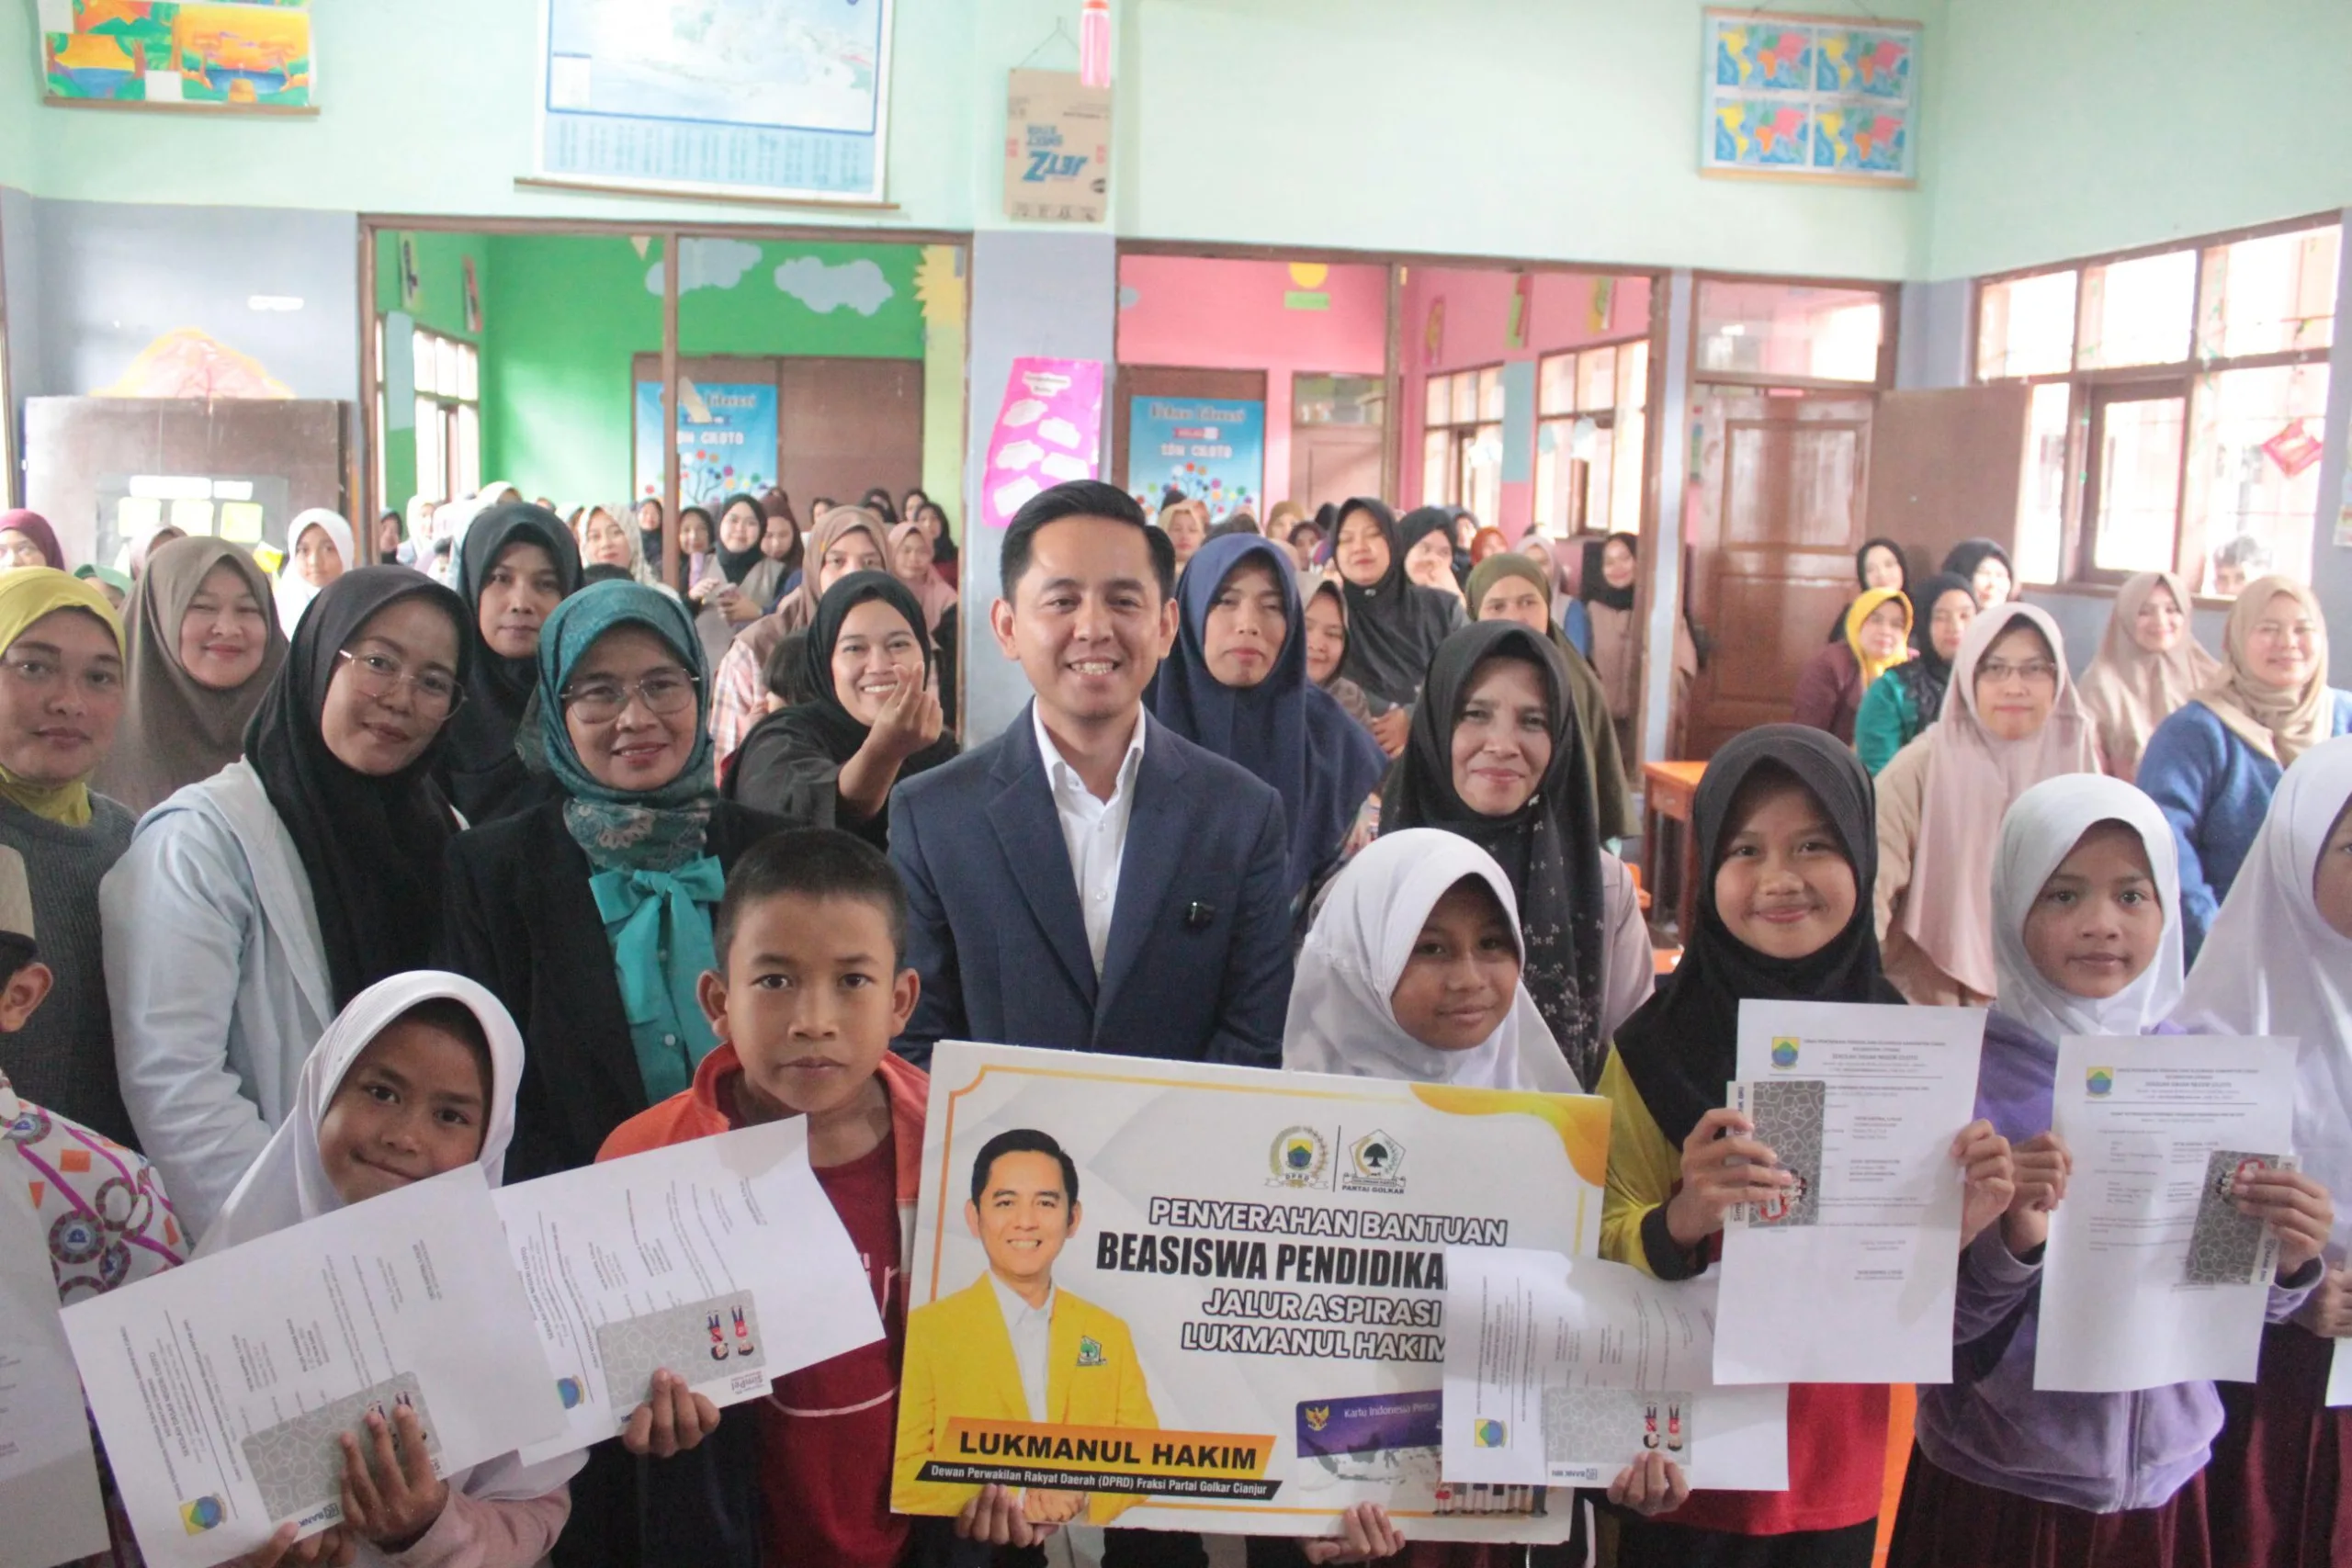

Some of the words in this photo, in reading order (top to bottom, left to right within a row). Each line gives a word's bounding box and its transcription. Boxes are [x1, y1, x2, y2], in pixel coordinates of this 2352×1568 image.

[1149, 1197, 1357, 1238] PENYERAHAN
[1361, 1211, 1508, 1247] BANTUAN
[1097, 1232, 1267, 1280] BEASISWA
[1276, 1244, 1448, 1290] PENDIDIKA
[1202, 1288, 1302, 1319] JALUR
[1304, 1294, 1441, 1326] ASPIRASI
[1182, 1323, 1351, 1359] LUKMANUL
[1344, 1407, 1367, 1418] Kartu
[1369, 1404, 1410, 1416] Indonesia
[960, 1431, 1140, 1463] LUKMANUL
[1152, 1443, 1256, 1470] HAKIM
[931, 1465, 965, 1477] Dewan
[967, 1468, 1022, 1481] Perwakilan
[1024, 1472, 1057, 1484] Rakyat
[1060, 1474, 1095, 1485] Daerah
[1098, 1476, 1134, 1489] (DPRD)
[1136, 1478, 1166, 1490] Fraksi
[1169, 1480, 1197, 1491] Partai
[1200, 1482, 1230, 1493] Golkar
[1233, 1483, 1267, 1495] Cianjur
